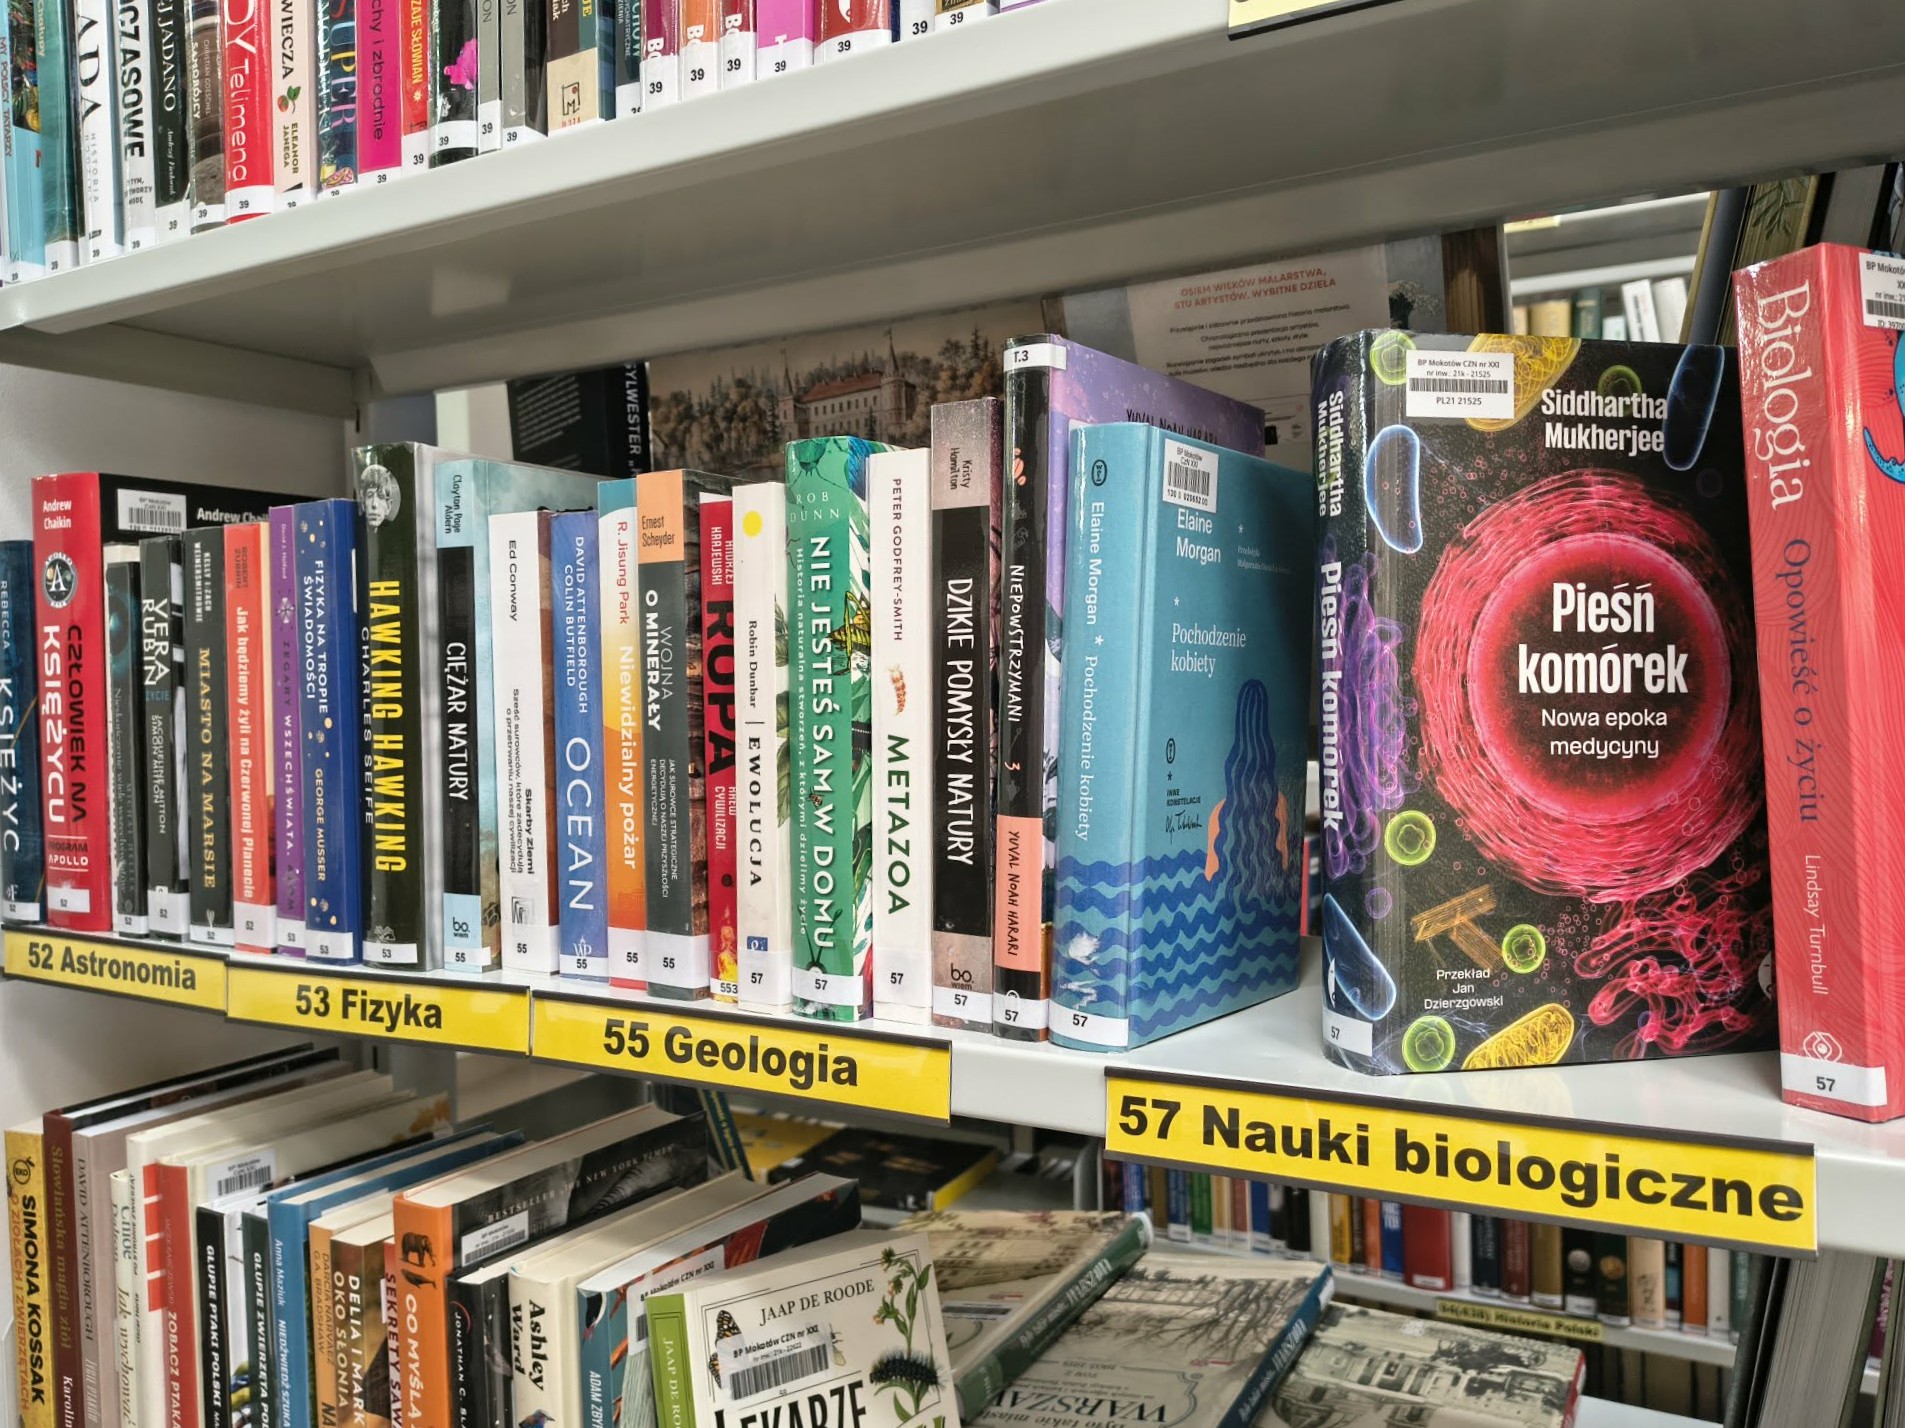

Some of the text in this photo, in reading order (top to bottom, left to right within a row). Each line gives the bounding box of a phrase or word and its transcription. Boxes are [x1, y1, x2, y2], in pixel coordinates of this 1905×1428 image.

[912, 20, 928, 36] 39
[950, 12, 964, 25] 39
[412, 29, 423, 84] SŁOWIAN
[727, 58, 741, 72] 39
[774, 60, 787, 73] 39
[838, 39, 851, 52] 39
[373, 50, 384, 140] zbrodnie
[649, 81, 663, 94] 39
[690, 68, 704, 82] 39
[229, 58, 249, 181] Telimena
[439, 136, 449, 146] 39
[482, 123, 494, 134] 39
[506, 131, 518, 142] 39
[377, 174, 387, 184] 39
[413, 154, 424, 165] 39
[168, 220, 177, 230] 39
[198, 208, 208, 218] 39
[239, 200, 250, 210] 39
[1417, 358, 1427, 367] BP
[1428, 358, 1462, 368] Mokotów
[1463, 360, 1478, 368] CZN
[1436, 396, 1482, 406] PL21 21525
[1541, 388, 1668, 421] Siddhartha
[1753, 278, 1812, 511] Biologia
[1317, 400, 1328, 517] Mukherjee
[1326, 390, 1344, 517] Siddhartha
[1544, 422, 1664, 457] Mukherjee
[950, 448, 958, 490] Hamilton
[962, 459, 973, 489] Kristy
[42, 499, 72, 512] Andrew
[453, 512, 462, 534] Page
[642, 515, 665, 531] Ernest
[1176, 508, 1213, 535] Elaine
[642, 532, 675, 549] Scheyder
[892, 478, 903, 641] PETER GODFREY-SMITH
[1085, 502, 1105, 626] Elaine Morgan
[1176, 536, 1222, 565] Morgan
[509, 540, 518, 622] Ed Conway
[616, 540, 629, 625] Jisung Park
[564, 564, 576, 687] COLIN BUTFIELD
[575, 536, 588, 714] DAVID ATTENBOROUGH
[1552, 582, 1655, 634] Pieśń
[142, 599, 156, 686] RUBIN
[154, 598, 170, 680] VERA
[304, 576, 316, 698] ŚWIADOMOŚCI
[315, 560, 328, 714] FIZYKA NA TROPIE
[1008, 564, 1025, 722] NIEPOWSTRZYMANI
[1172, 622, 1247, 648] Pochodzenie
[645, 590, 661, 732] O MINERAŁY
[660, 626, 673, 700] WOJNA
[748, 620, 758, 708] Robin Dunbar
[1170, 649, 1217, 678] kobiety
[1518, 642, 1689, 695] komórek
[1774, 538, 1826, 823] Opowieść o życiu
[444, 642, 469, 801] CIĘŻAR NATURY
[1320, 561, 1345, 832] Pieśń komórek
[1542, 708, 1669, 731] Nowa epoka
[41, 625, 67, 823] KSIĘŻYCU
[361, 627, 374, 824] CHARLES SEIFE
[369, 580, 407, 872] HAWKING HAWKING
[810, 536, 838, 948] NIE JESTEŚ SAM W DOMU
[946, 578, 974, 866] DZIKIE POMYSŁY NATURY
[200, 648, 216, 888] MIASTO NA MARSIE
[236, 607, 256, 898] Jak będziemy żyli na Czerwonej Planecie
[618, 646, 640, 870] Niewidzialny pożar
[1074, 656, 1099, 842] Pochodzenie kobiety
[1550, 736, 1660, 760] medycyny
[316, 768, 326, 881] GEORGE MUSSER
[526, 788, 535, 875] Skarby Ziemi
[566, 737, 594, 911] OCEAN
[714, 786, 726, 850] CYWILIZACJI
[748, 736, 762, 886] EWOLUCJA
[887, 734, 910, 915] METAZOA
[670, 820, 678, 880] STRATEGICZNE
[1007, 831, 1020, 957] YUVAL NOAH HARARI
[320, 944, 329, 954] 53
[516, 943, 527, 954] 55
[1803, 854, 1829, 995] Lindsay Turnbull
[28, 942, 198, 990] 52 Astronomia
[382, 949, 392, 958] 53
[454, 952, 466, 963] 55
[576, 959, 588, 969] 55
[626, 952, 638, 964] 55
[662, 957, 675, 968] 55
[750, 972, 763, 985] 57
[890, 972, 904, 985] 57
[1436, 968, 1491, 982] Przekład
[295, 984, 443, 1034] 53 Fizyka
[814, 979, 828, 990] 57
[954, 994, 968, 1006] 57
[1424, 996, 1504, 1011] Dzierzgowski
[1452, 983, 1475, 994] Jan
[1004, 1009, 1019, 1022] 57
[1072, 1014, 1088, 1029] 57
[1331, 1026, 1341, 1038] 57
[603, 1018, 859, 1090] 55 Geologia
[1816, 1076, 1836, 1092] 57
[1118, 1095, 1182, 1140] 57
[1202, 1104, 1370, 1168] Nauki
[1396, 1126, 1805, 1222] biologiczne
[22, 1194, 45, 1405] SIMONA KOSSAK
[405, 1293, 418, 1333] CO
[759, 1278, 876, 1327] JAAP DE ROODE
[168, 1311, 180, 1377] ZOBACZ
[206, 1245, 222, 1408] GŁUPIE PTAKI POLSKI
[333, 1271, 350, 1408] OKO SŁONIA
[385, 1272, 400, 1378] SEKRETY
[455, 1312, 468, 1382] JONATHAN
[512, 1303, 526, 1375] Ward
[528, 1299, 549, 1391] Ashley
[348, 1275, 366, 1426] DELIA MARK
[664, 1338, 676, 1372] JAAP
[590, 1370, 601, 1399] ADAM
